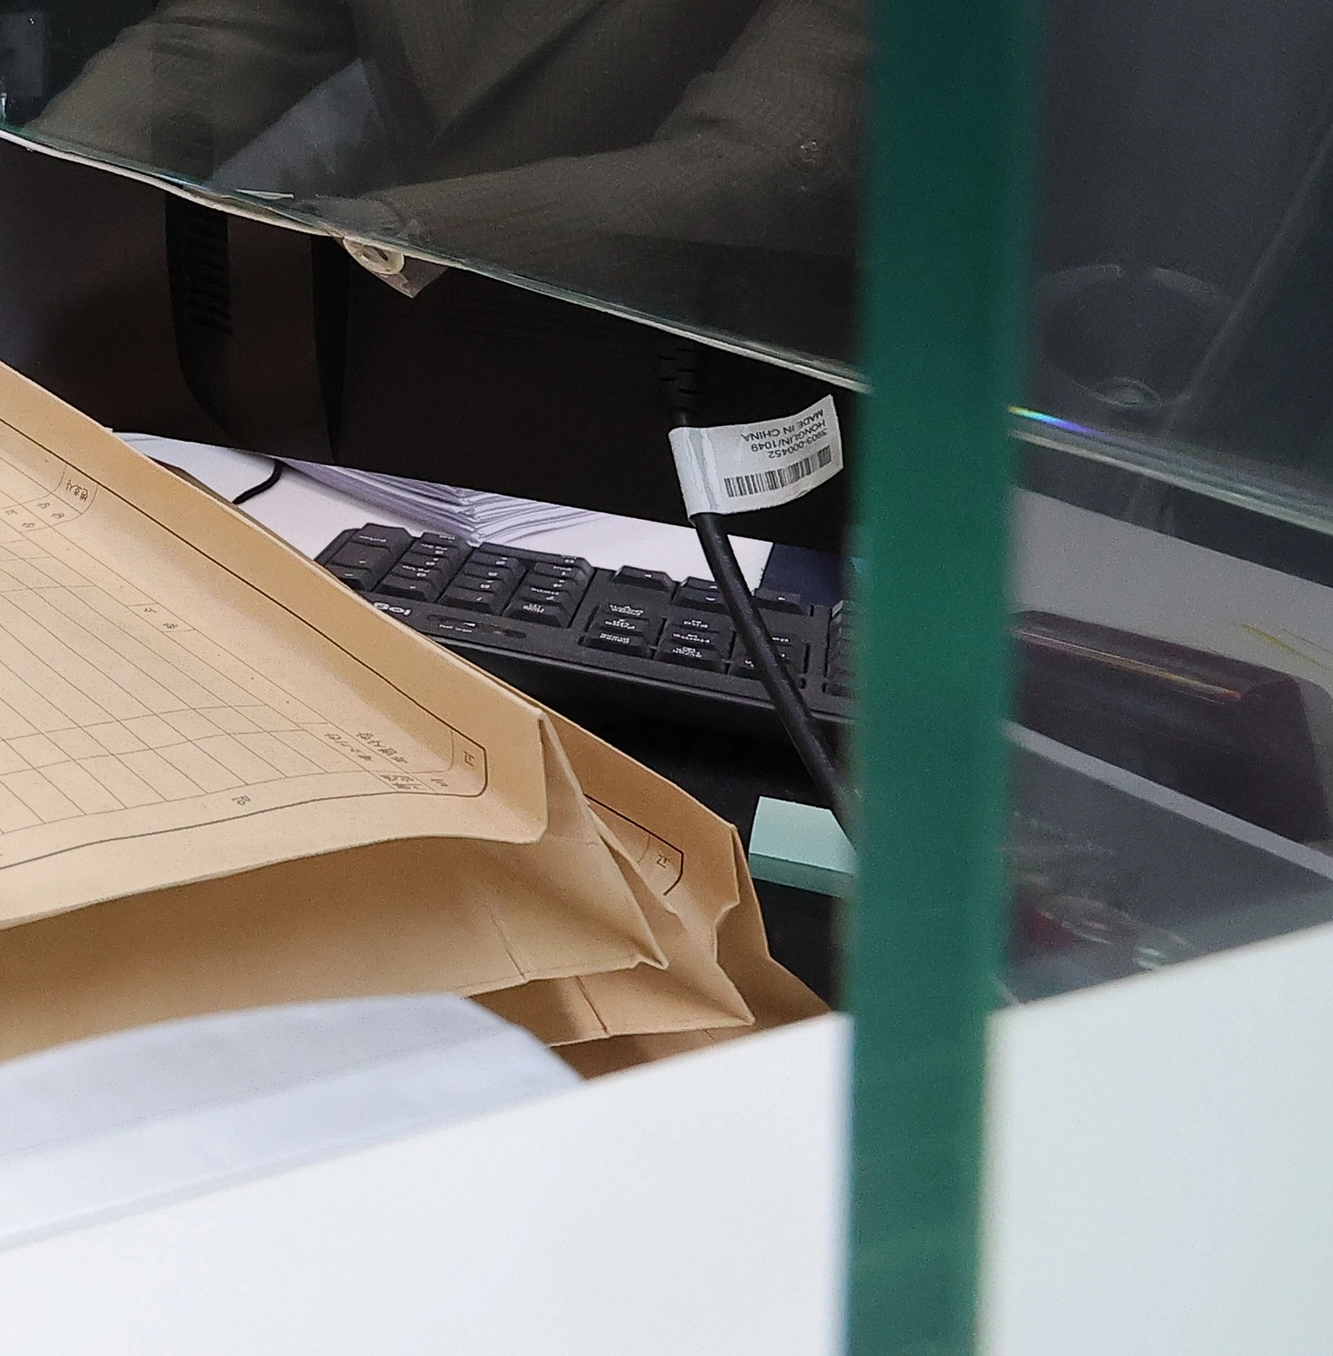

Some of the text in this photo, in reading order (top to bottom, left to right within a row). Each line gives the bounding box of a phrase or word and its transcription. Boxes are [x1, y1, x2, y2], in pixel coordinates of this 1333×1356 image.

[741, 409, 824, 442] MADE IN CHINA
